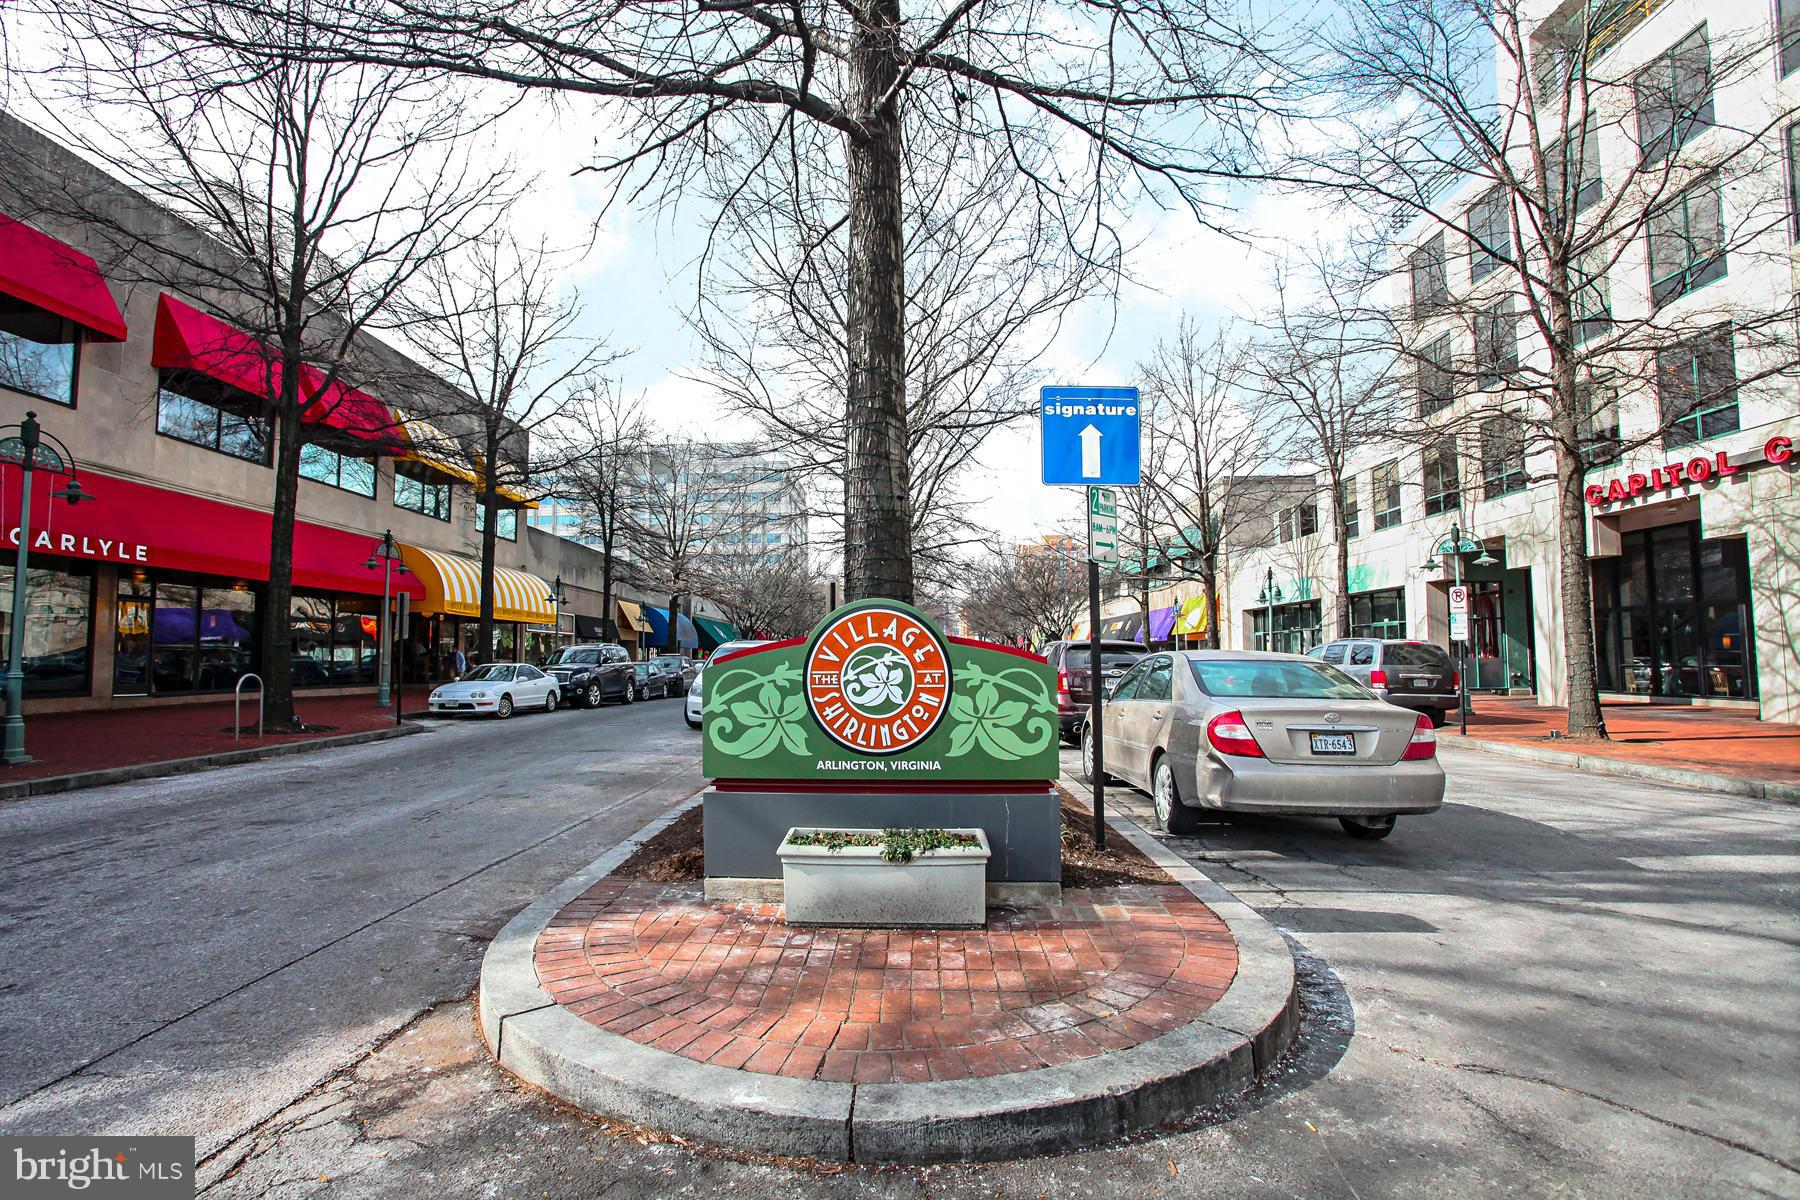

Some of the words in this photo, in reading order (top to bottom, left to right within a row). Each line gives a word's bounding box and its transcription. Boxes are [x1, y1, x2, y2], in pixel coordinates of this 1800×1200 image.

[1044, 402, 1137, 418] signature
[1585, 451, 1739, 506] CAPITOL
[1092, 489, 1098, 512] 2
[9, 527, 148, 562] CARLYLE
[817, 615, 935, 663] VILLAGE
[812, 674, 839, 685] THE
[923, 673, 942, 684] AT
[813, 691, 940, 747] SHIRLINGTON
[1313, 738, 1353, 750] XTR-6543
[816, 760, 888, 772] ARLINGTON,
[890, 760, 942, 771] VIRGINIA
